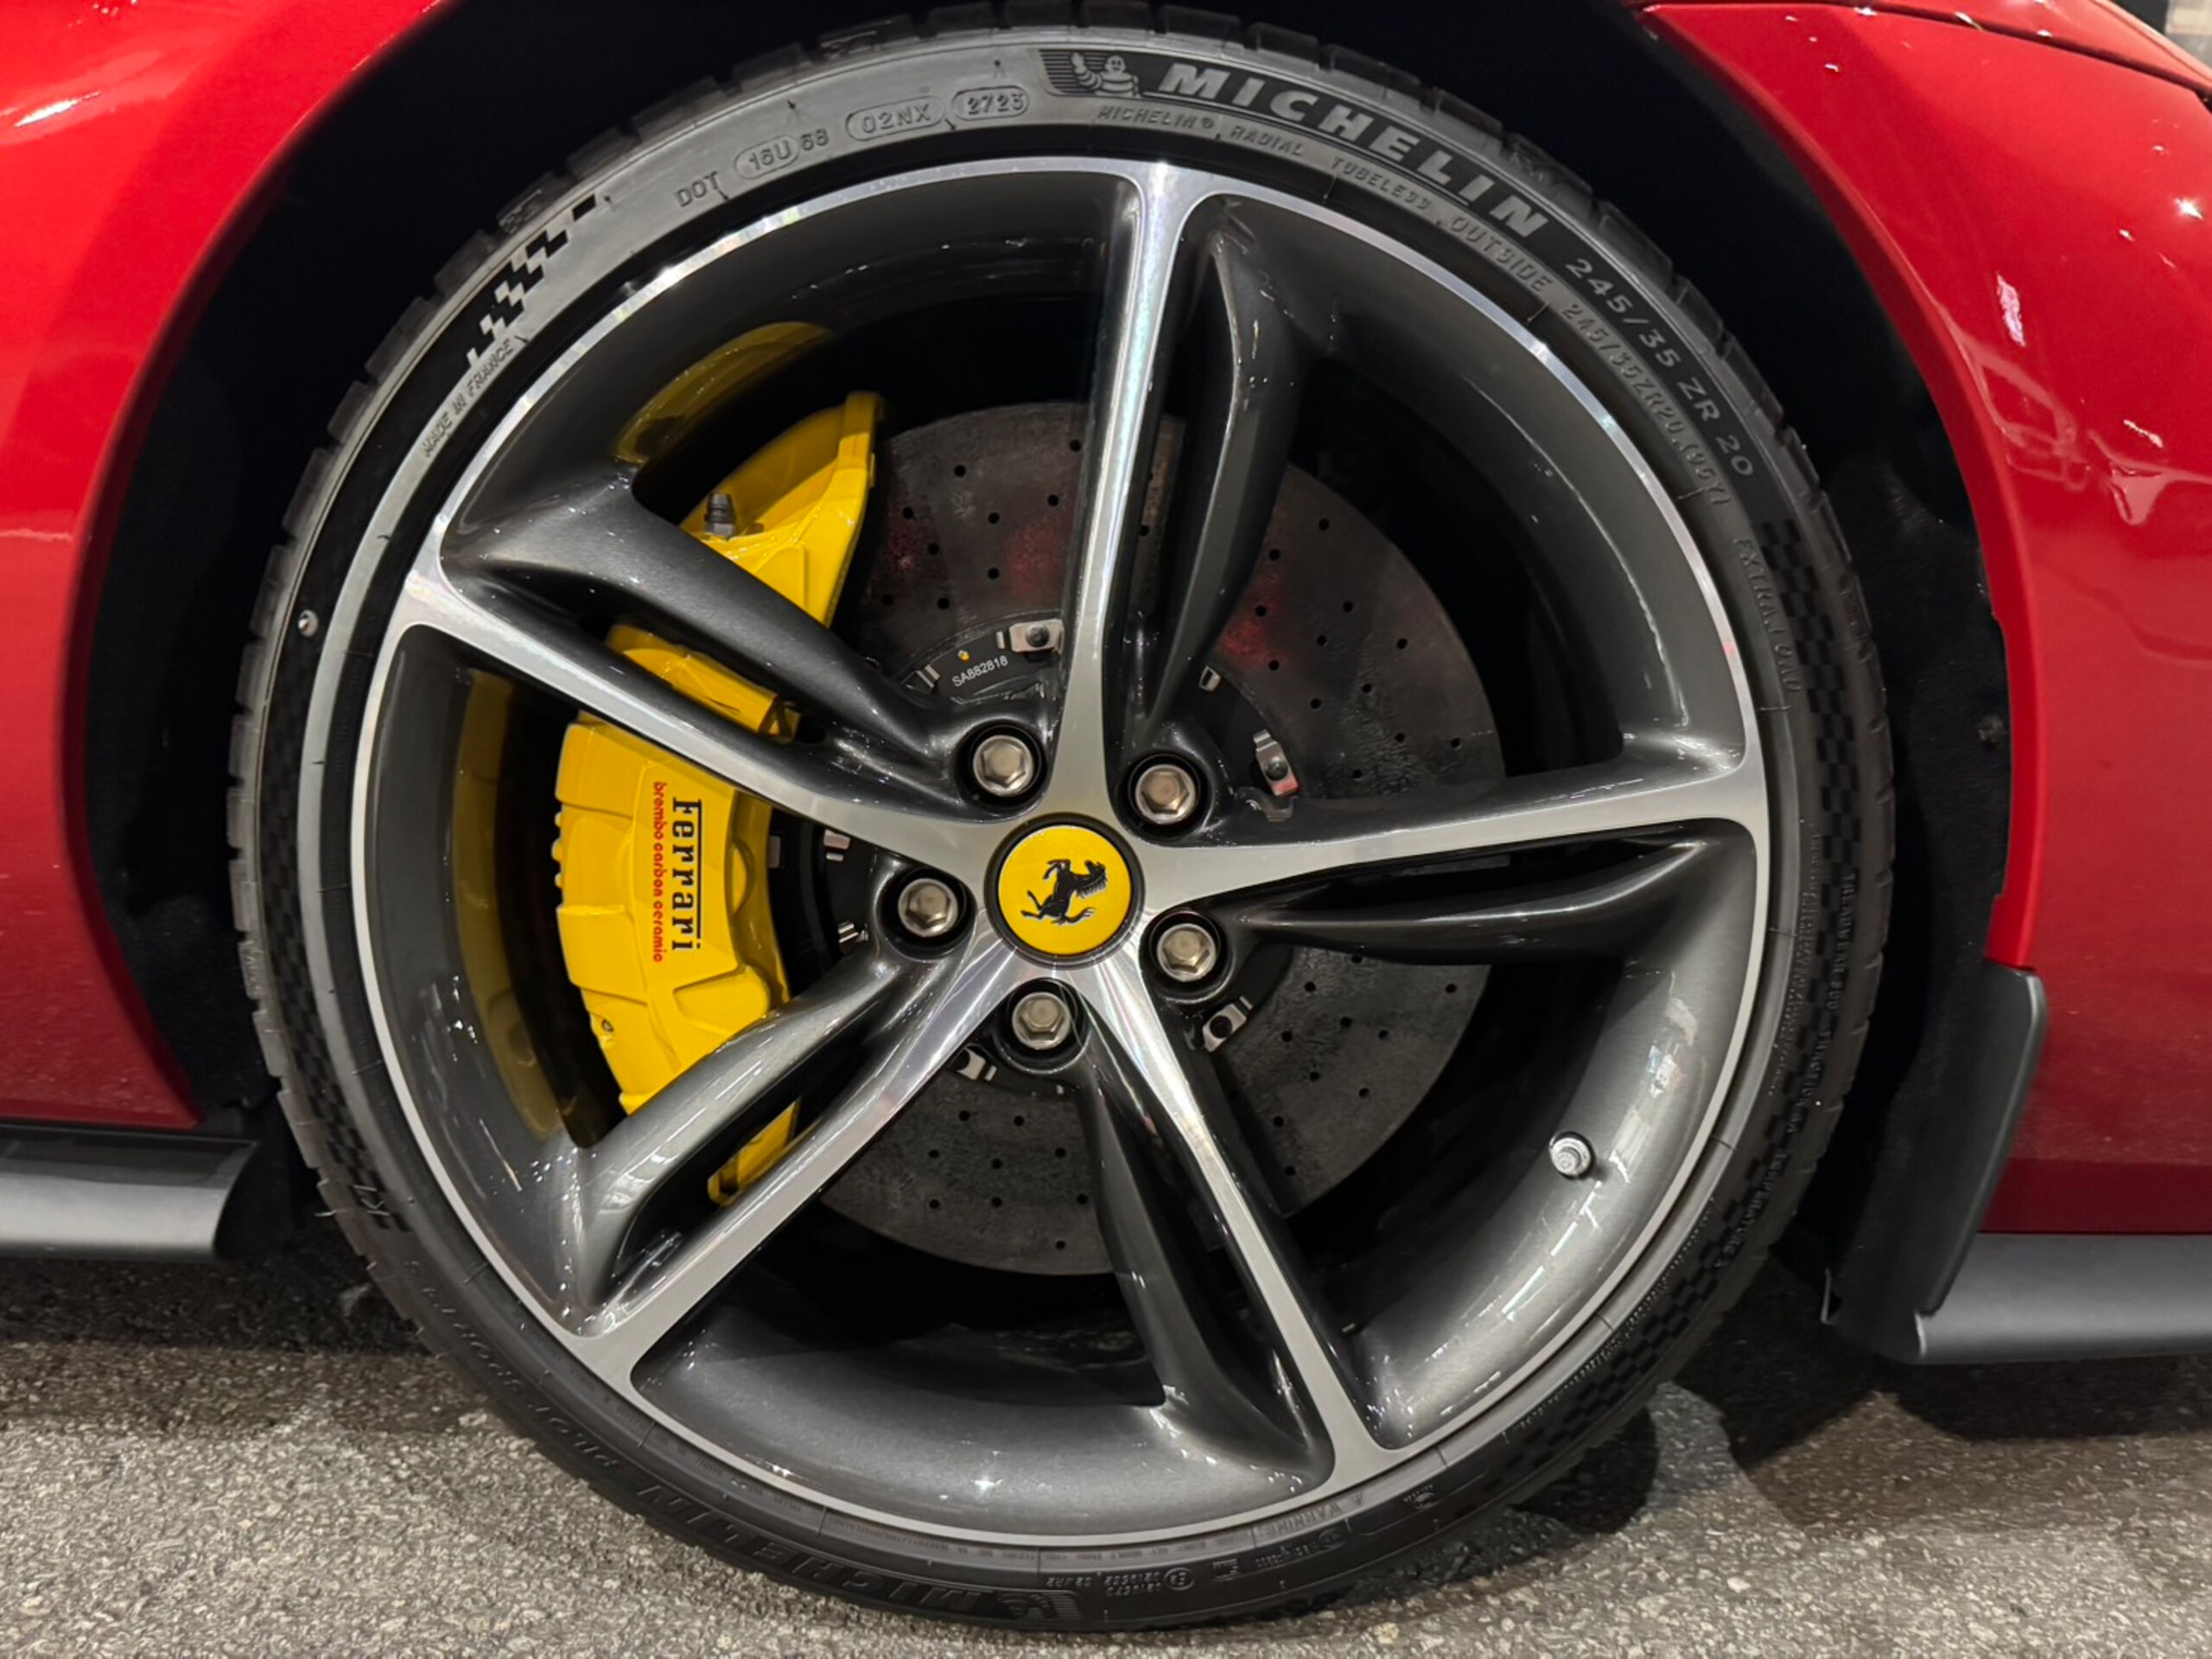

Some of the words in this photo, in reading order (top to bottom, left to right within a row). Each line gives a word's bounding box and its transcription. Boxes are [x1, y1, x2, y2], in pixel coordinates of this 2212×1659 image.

[675, 170, 719, 207] DOT
[966, 92, 1025, 117] 2723
[1157, 63, 1548, 238] MICHELIN
[1228, 124, 1305, 156] RADIAL
[1330, 156, 1432, 211] TUBELESS
[1449, 216, 1553, 293] OUTSIDE
[421, 410, 453, 458] MADE
[452, 393, 467, 415] IN
[466, 338, 514, 397] FRANCE
[1565, 258, 1682, 368] 245/35
[1676, 376, 1721, 423] ZR
[1716, 434, 1753, 476] 20
[951, 654, 1009, 688] SA882818
[653, 782, 667, 841] brembo
[653, 842, 667, 897] carbon
[652, 900, 666, 963] ceramic
[671, 797, 702, 951] Ferrari
[636, 1482, 982, 1614] MICHELIN
